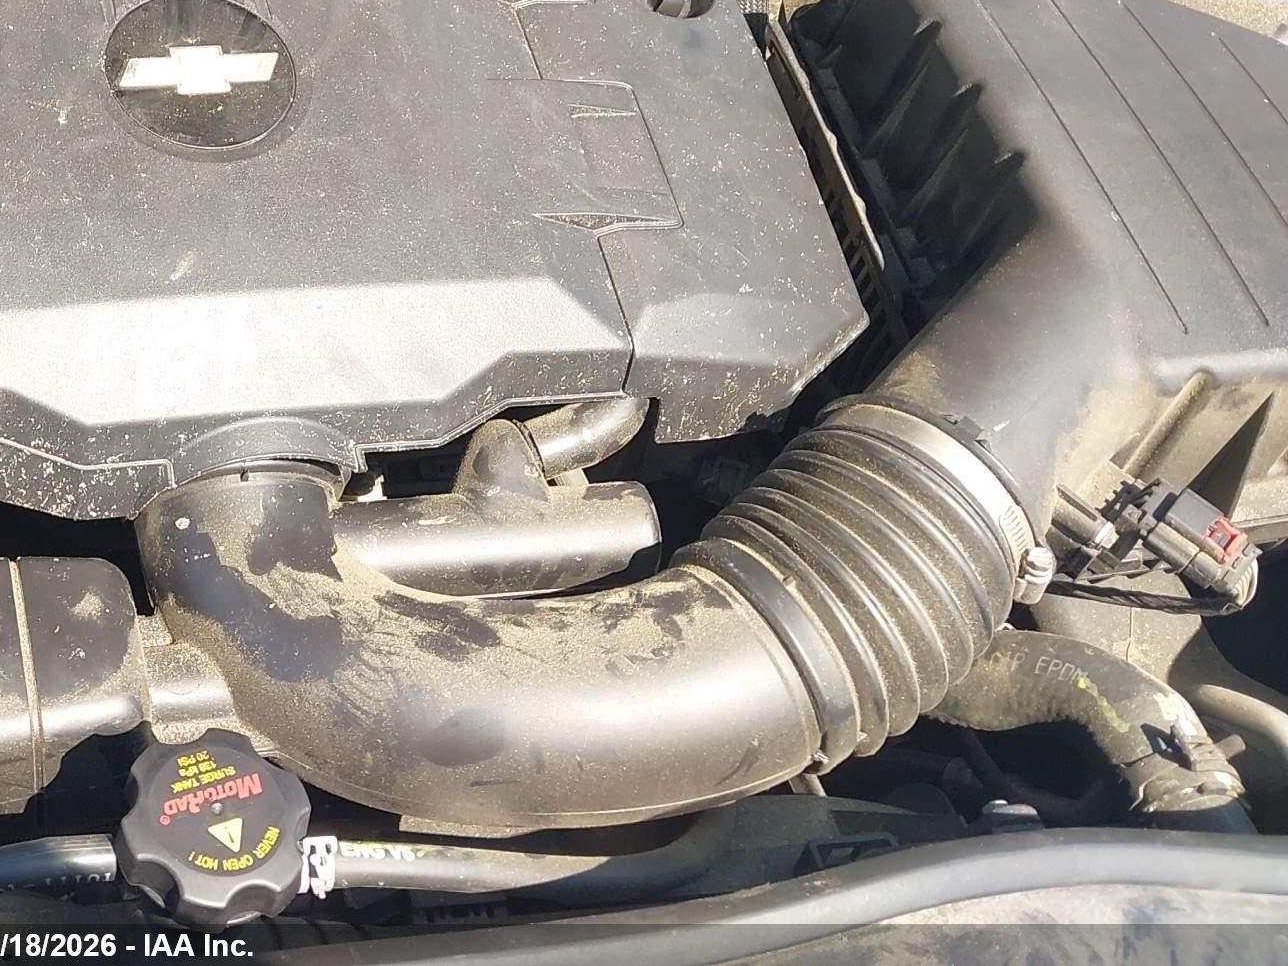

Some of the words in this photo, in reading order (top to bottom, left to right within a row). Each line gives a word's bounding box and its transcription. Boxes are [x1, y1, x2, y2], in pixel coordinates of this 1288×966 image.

[177, 754, 196, 767] PSI
[196, 750, 210, 761] 20
[199, 766, 236, 785] SURGE
[170, 777, 201, 794] TANK
[253, 826, 280, 859] NEVER
[222, 854, 254, 871] OPEN
